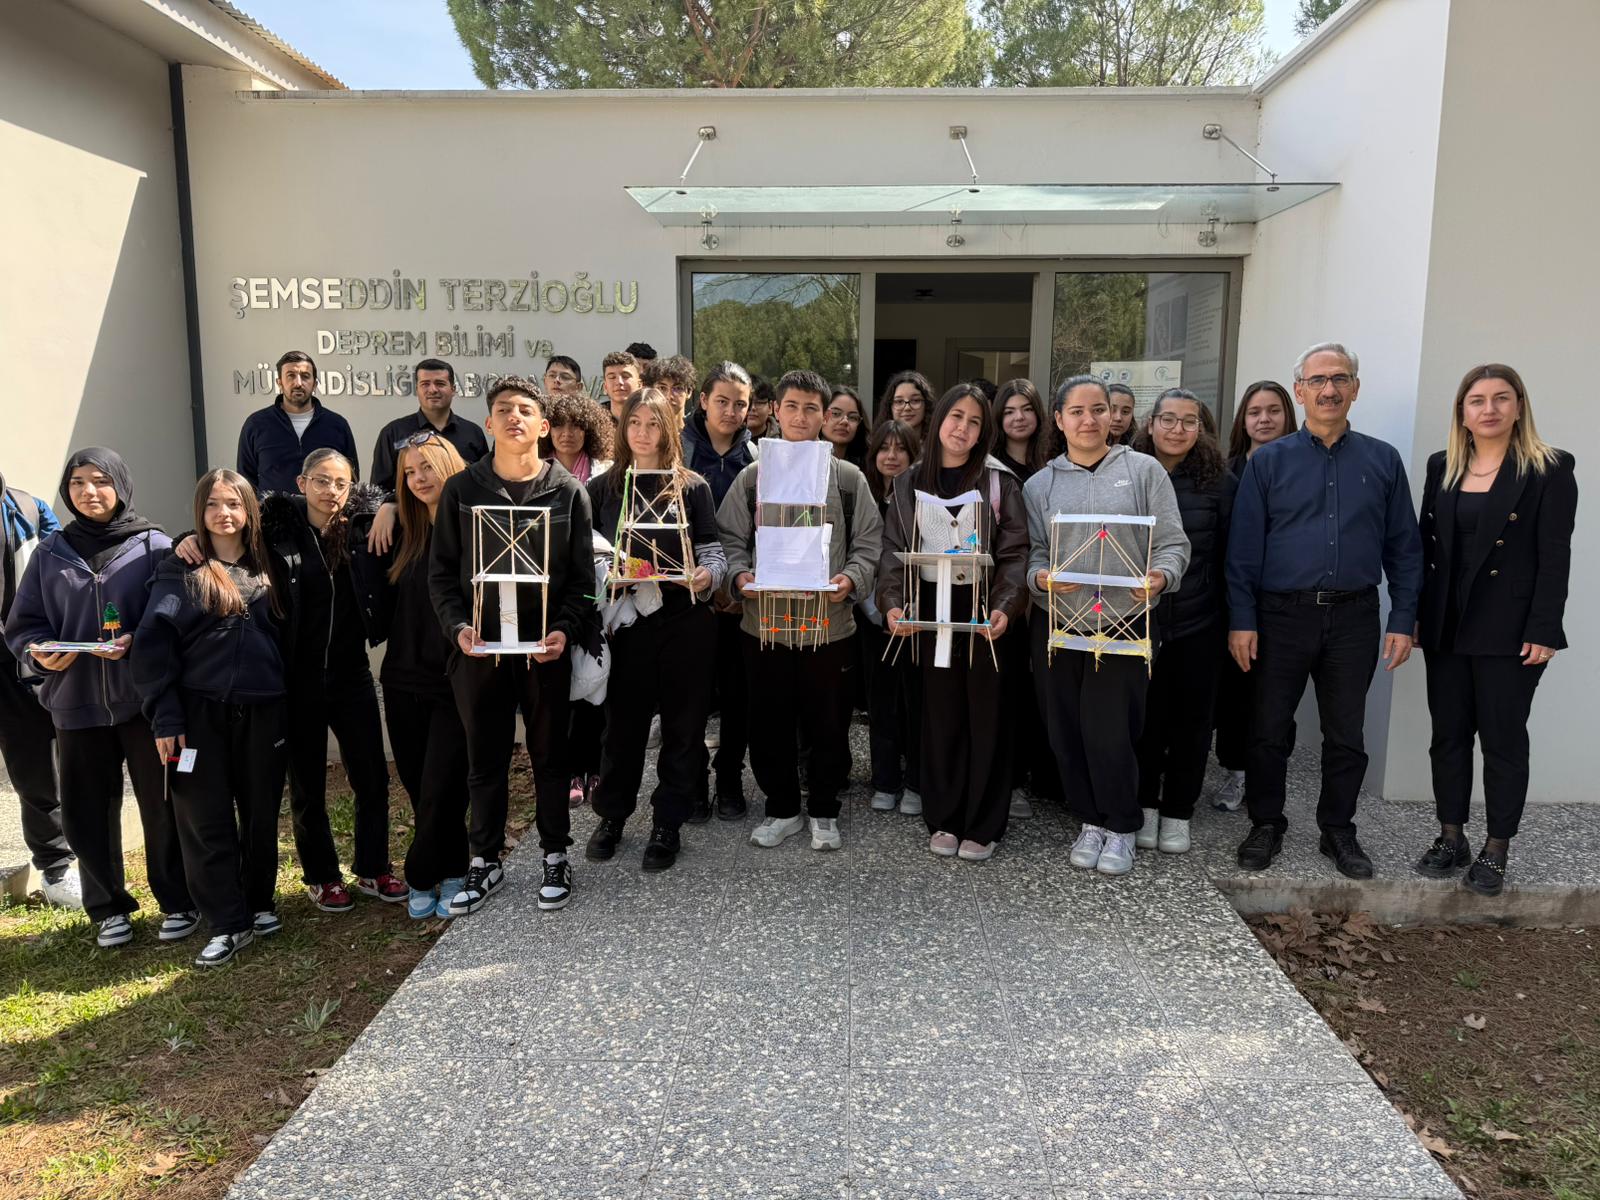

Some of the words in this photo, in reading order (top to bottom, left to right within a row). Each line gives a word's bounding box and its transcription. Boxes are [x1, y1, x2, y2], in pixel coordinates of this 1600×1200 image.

[230, 269, 426, 319] ŞEMSEDDİN
[439, 270, 639, 314] TERZİOĞLU
[316, 330, 427, 356] DEPREM
[435, 324, 516, 357] BİLİMİ
[524, 338, 555, 358] ve
